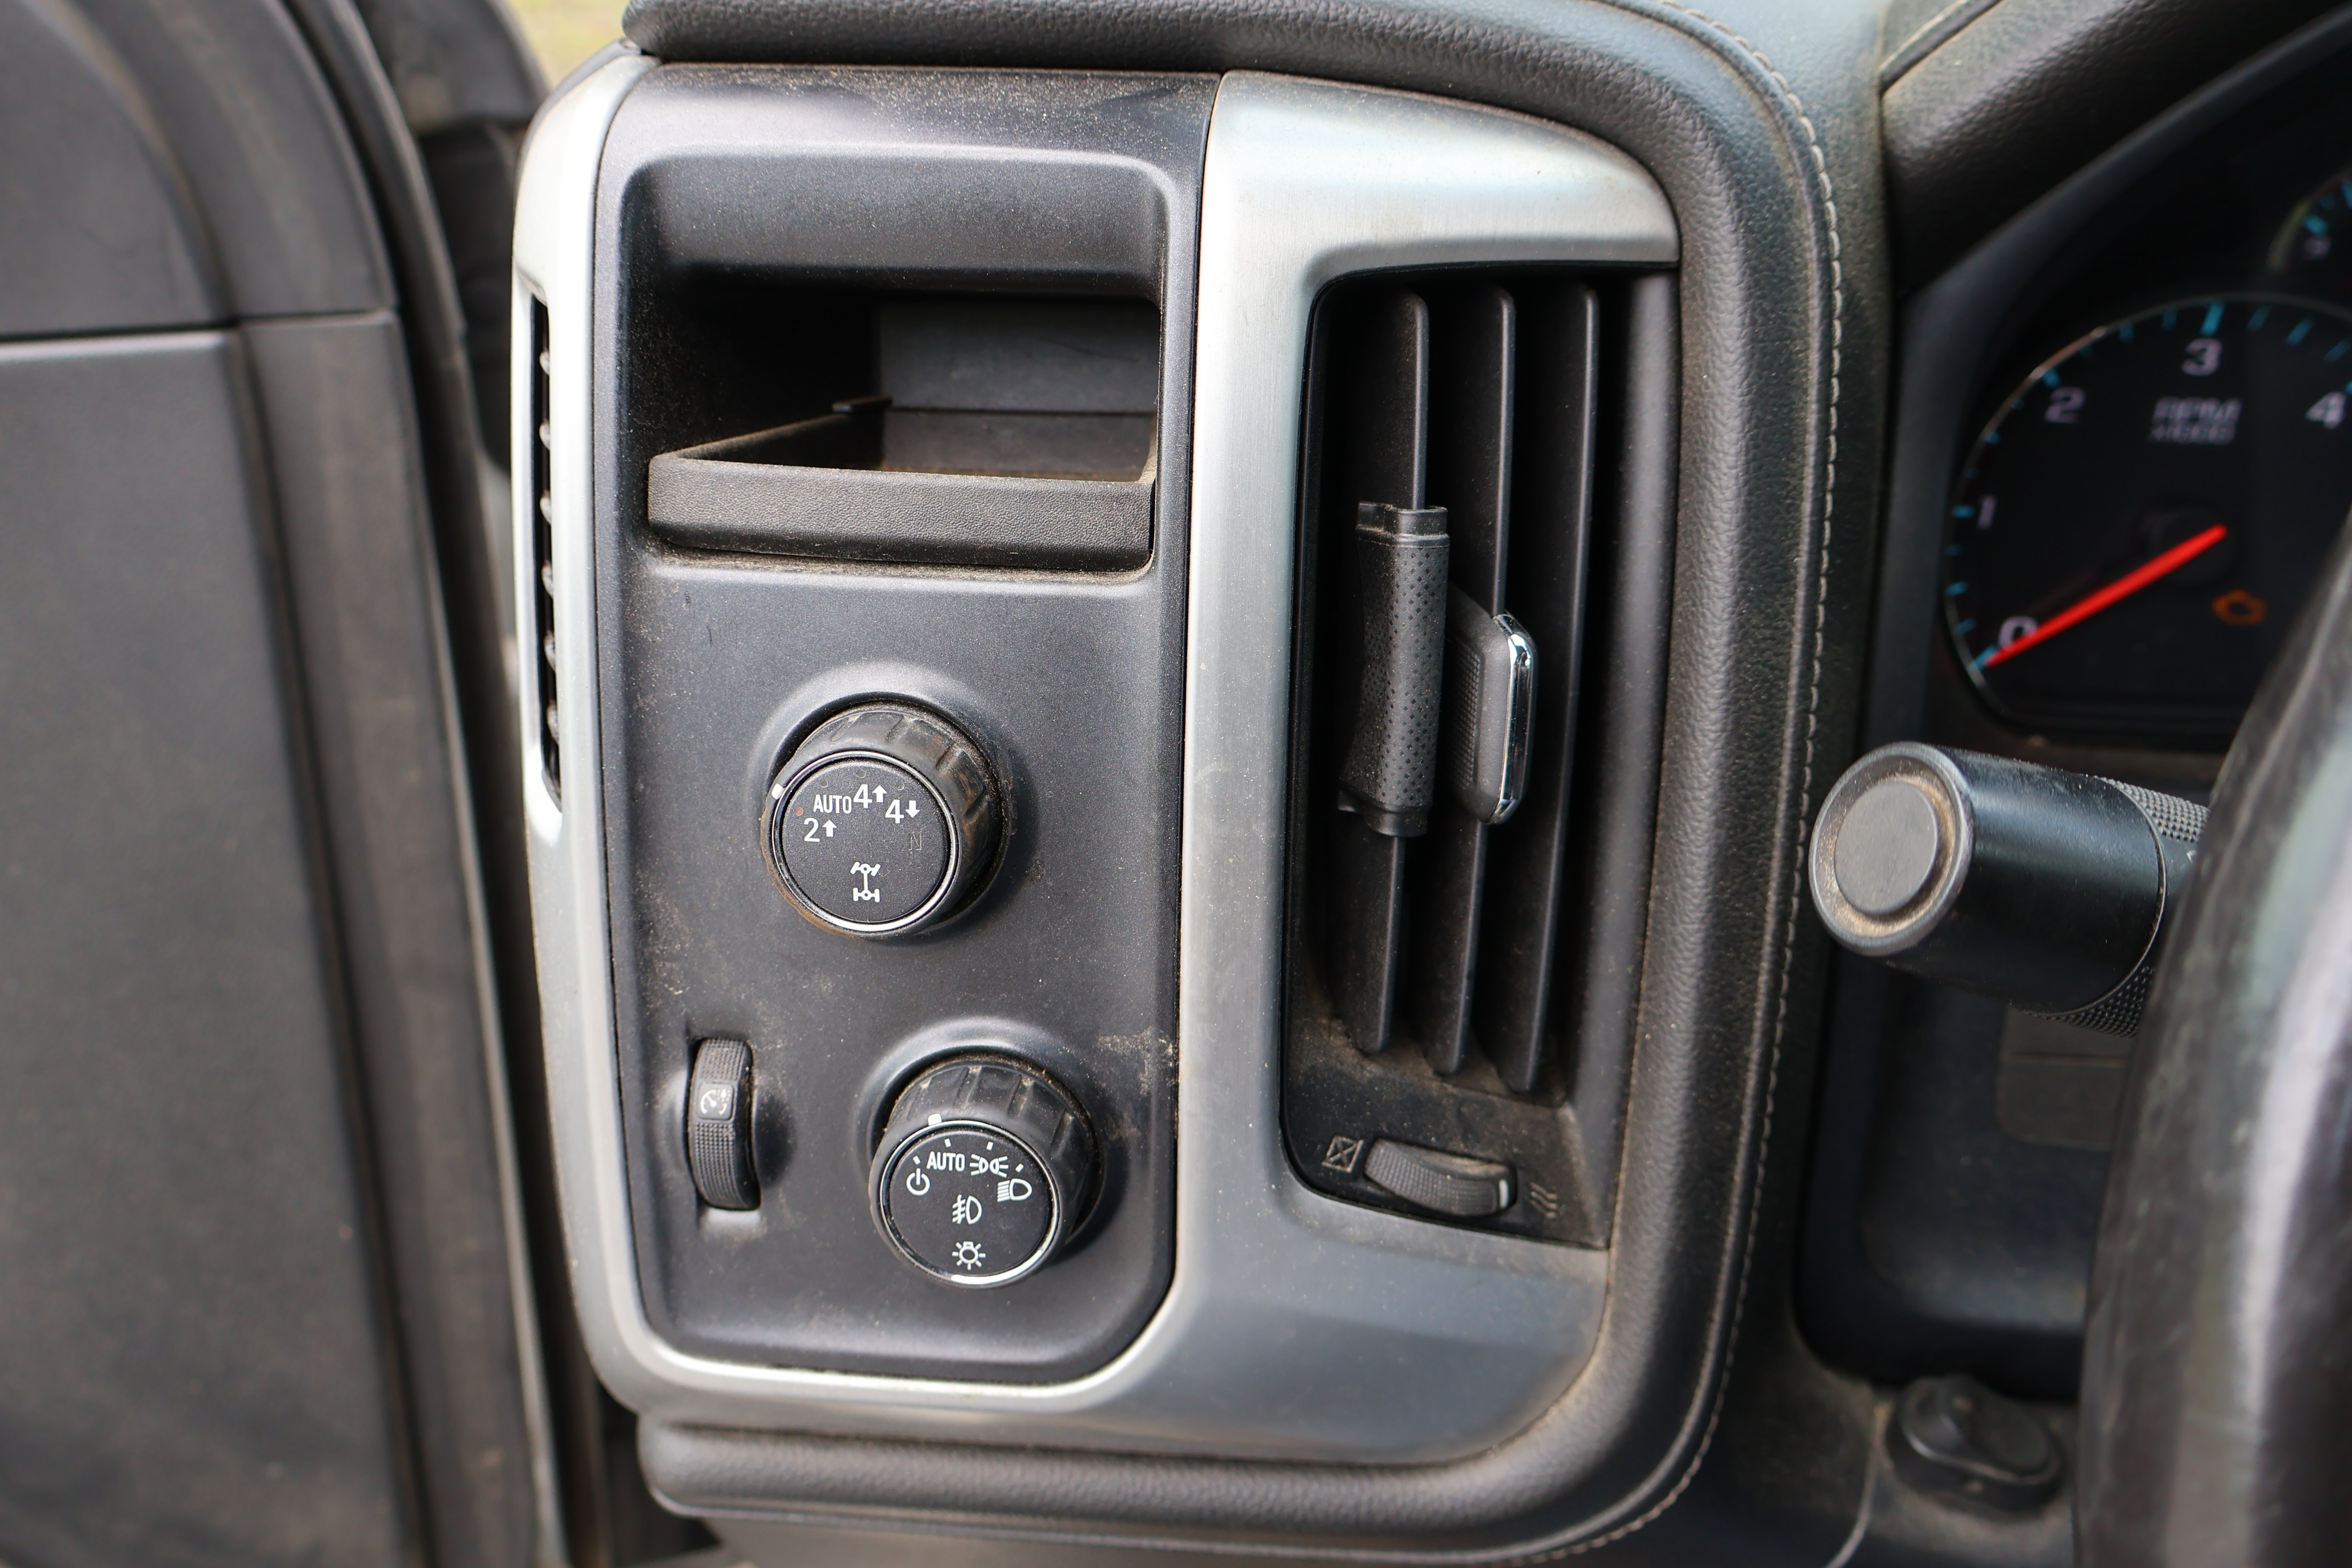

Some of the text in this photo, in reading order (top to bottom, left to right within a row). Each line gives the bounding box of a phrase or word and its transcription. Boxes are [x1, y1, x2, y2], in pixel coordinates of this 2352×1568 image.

[2182, 337, 2223, 376] 3
[2045, 386, 2085, 423] 2
[2305, 391, 2347, 430] 4
[1976, 495, 1996, 529] 1
[813, 794, 852, 814] AUTO
[853, 784, 873, 808] 4
[885, 799, 904, 824] 4
[804, 818, 820, 842] 2
[908, 831, 922, 851] N
[926, 1151, 965, 1172] AUTO
